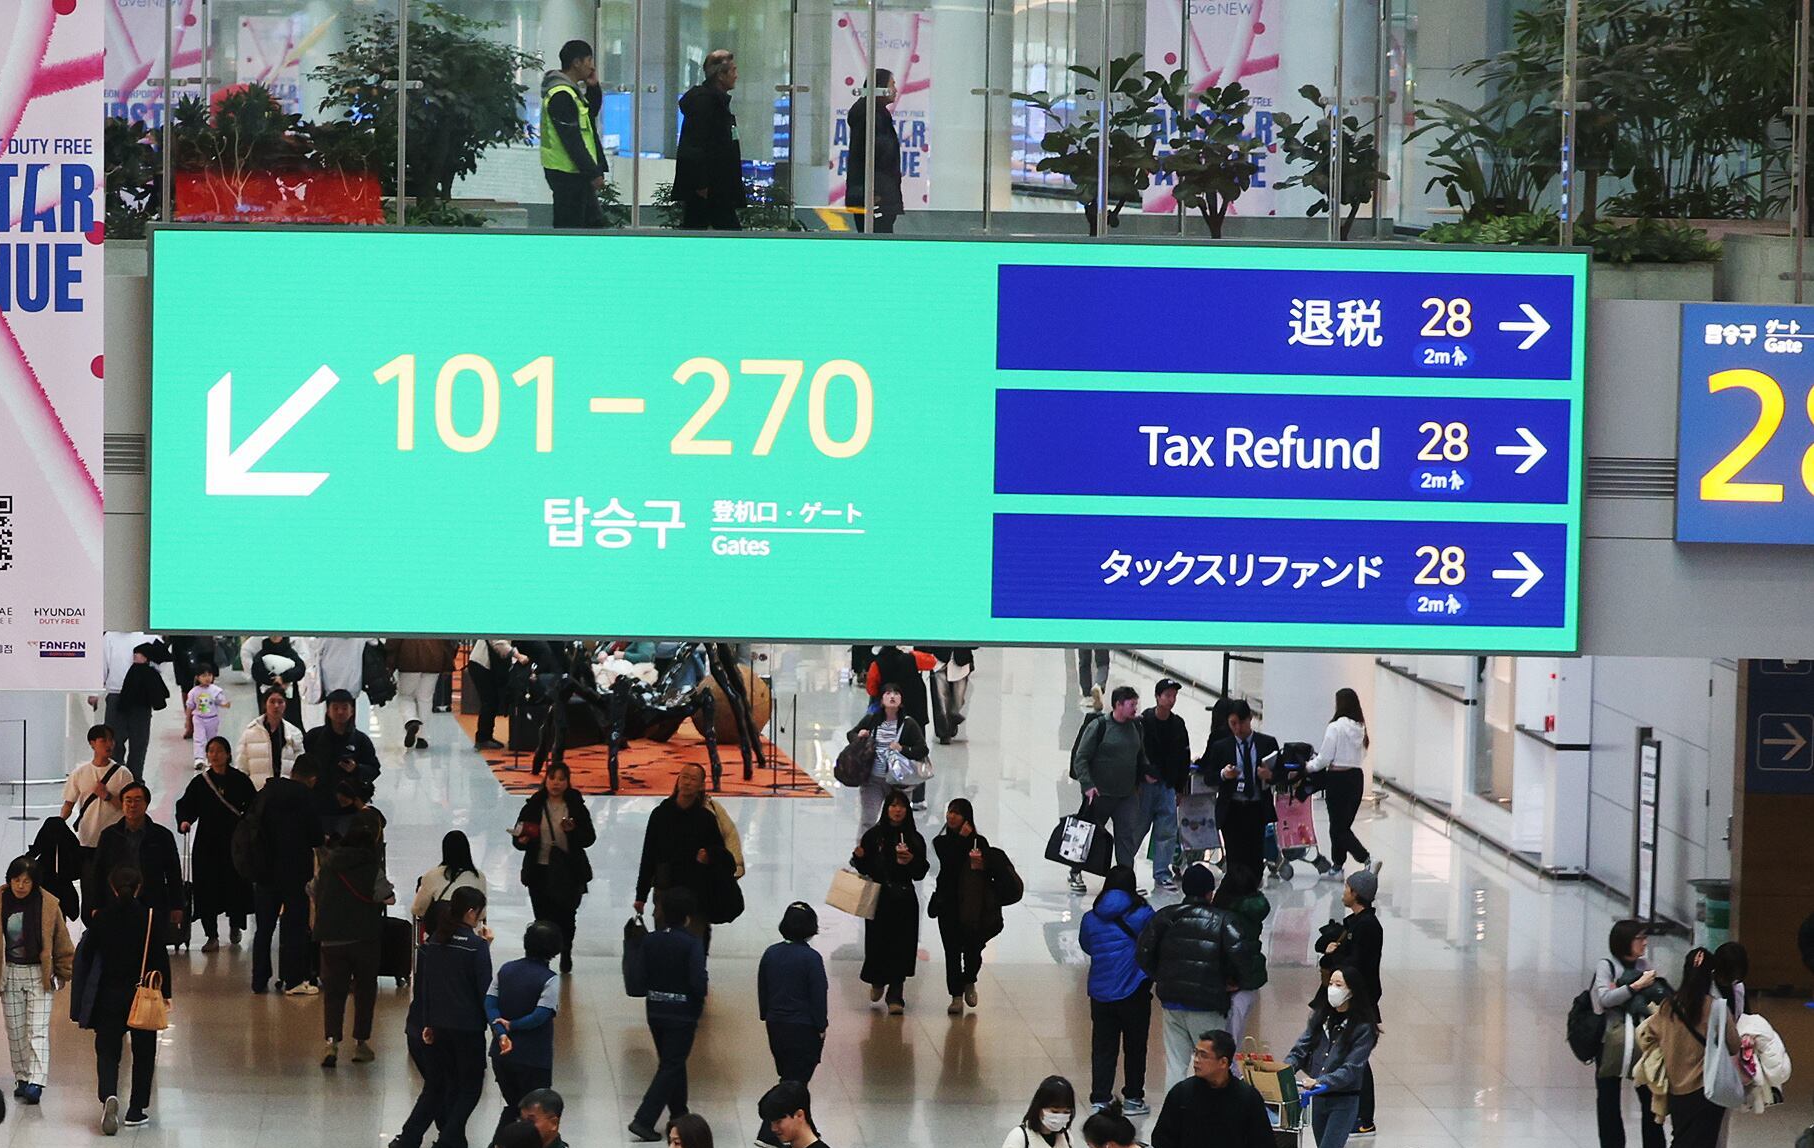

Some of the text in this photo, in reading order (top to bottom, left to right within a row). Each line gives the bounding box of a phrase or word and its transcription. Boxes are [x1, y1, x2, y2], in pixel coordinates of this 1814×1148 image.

[7, 138, 48, 155] DUTY
[54, 138, 92, 154] FREE
[1287, 298, 1384, 349] 退税
[1420, 297, 1473, 338] 28
[1764, 337, 1803, 353] Gate
[1423, 348, 1450, 365] 2m
[1138, 425, 1382, 470] Tax Refund
[1416, 422, 1470, 462] 28
[1420, 472, 1448, 490] 2m
[544, 497, 686, 550] 탑승구
[711, 535, 771, 557] Gates
[1100, 550, 1383, 592] タックスリファンド
[1414, 546, 1467, 586] 28
[34, 608, 86, 617] HYUNDAI
[1417, 596, 1444, 613] 2m
[39, 641, 86, 651] FANFAN
